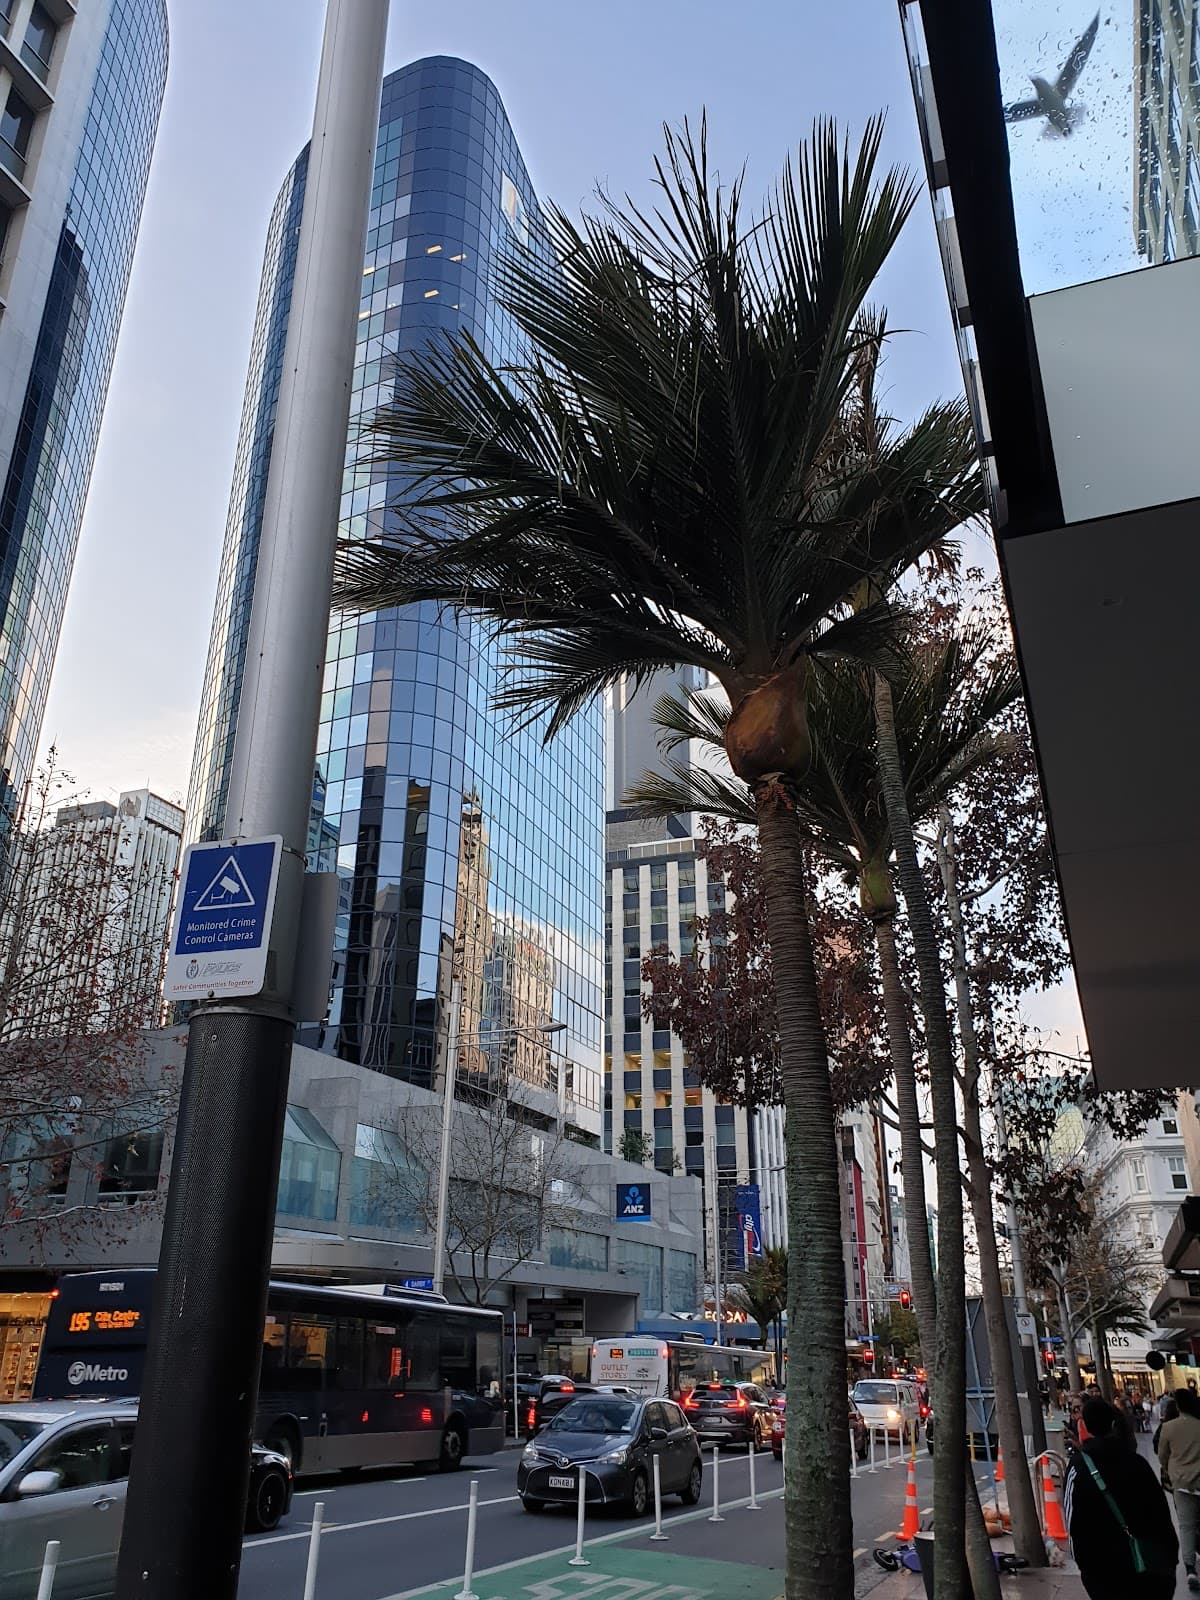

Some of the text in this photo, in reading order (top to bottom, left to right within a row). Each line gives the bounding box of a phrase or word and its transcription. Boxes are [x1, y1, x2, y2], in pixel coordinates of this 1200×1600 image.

[187, 918, 256, 932] Monitored Crime
[184, 931, 254, 945] Control Cameras
[188, 982, 226, 990] Communities
[623, 1204, 644, 1214] ANZ
[85, 1364, 128, 1381] Metro
